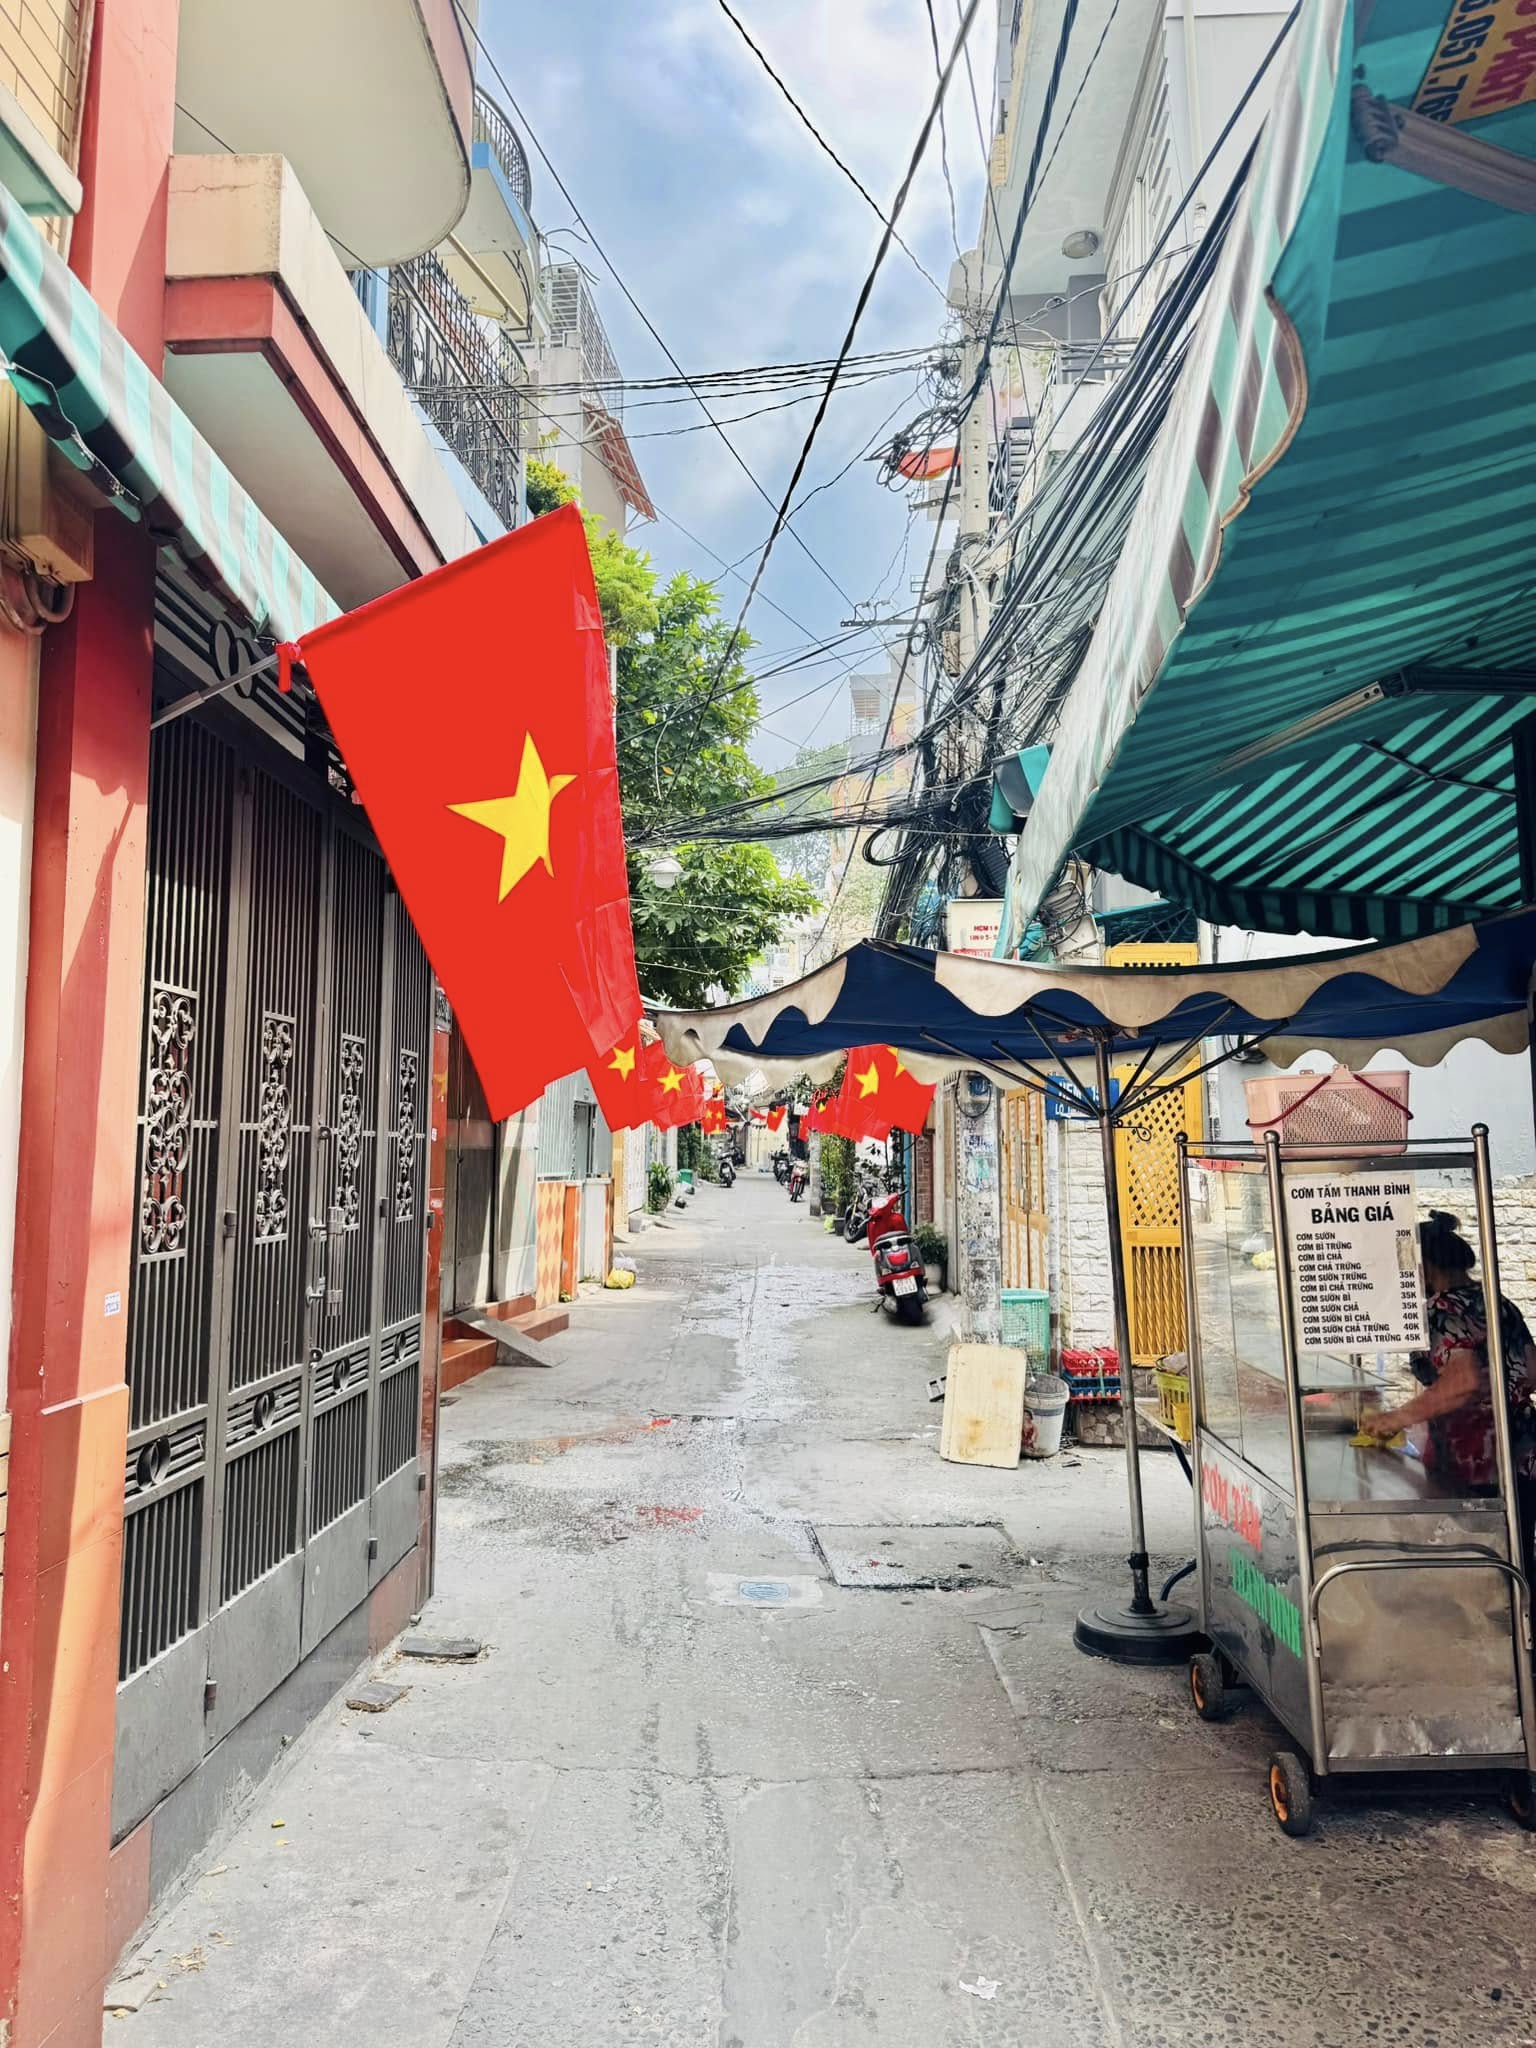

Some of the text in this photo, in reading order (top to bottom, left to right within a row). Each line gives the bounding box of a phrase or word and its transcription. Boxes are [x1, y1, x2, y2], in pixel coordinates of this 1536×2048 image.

[1291, 1182, 1410, 1199] CƠM TẤM THANH BÌNH
[1312, 1201, 1394, 1223] BẢNG GIÁ
[1327, 1251, 1342, 1260] CHẢ
[1317, 1262, 1332, 1271] CHẢ
[1329, 1282, 1344, 1290] CHẢ
[1344, 1302, 1359, 1311] CHẢ
[1355, 1312, 1370, 1321] CHẢ
[1345, 1324, 1360, 1332] CHẢ
[1357, 1334, 1372, 1342] CHẢ
